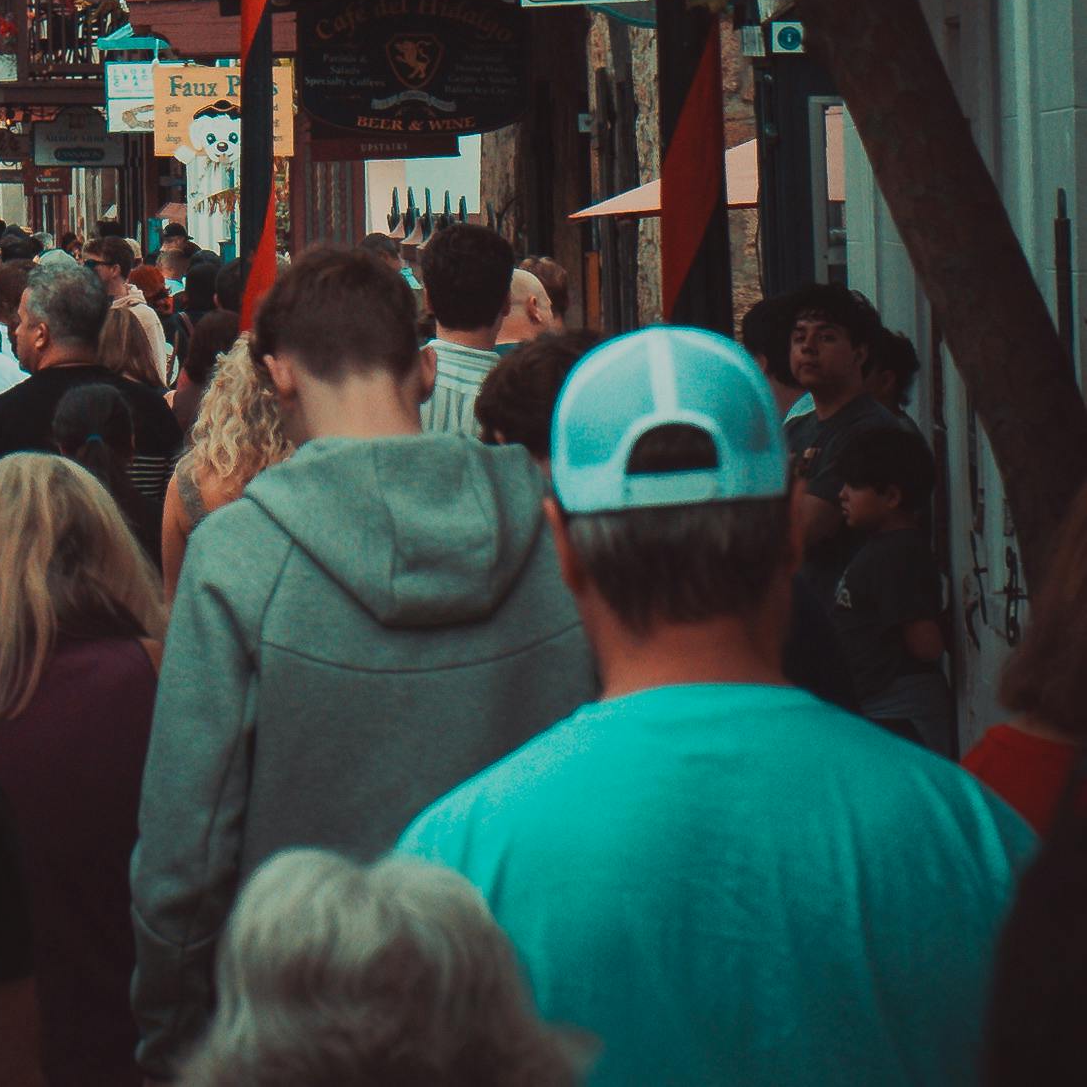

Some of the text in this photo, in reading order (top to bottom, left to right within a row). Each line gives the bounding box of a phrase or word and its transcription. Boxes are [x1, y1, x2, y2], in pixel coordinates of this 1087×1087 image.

[169, 75, 280, 96] Faux Ps
[165, 104, 181, 114] gifts
[167, 119, 179, 128] for
[356, 116, 477, 131] BEER & WINE
[359, 143, 408, 153] UPSTAIRS
